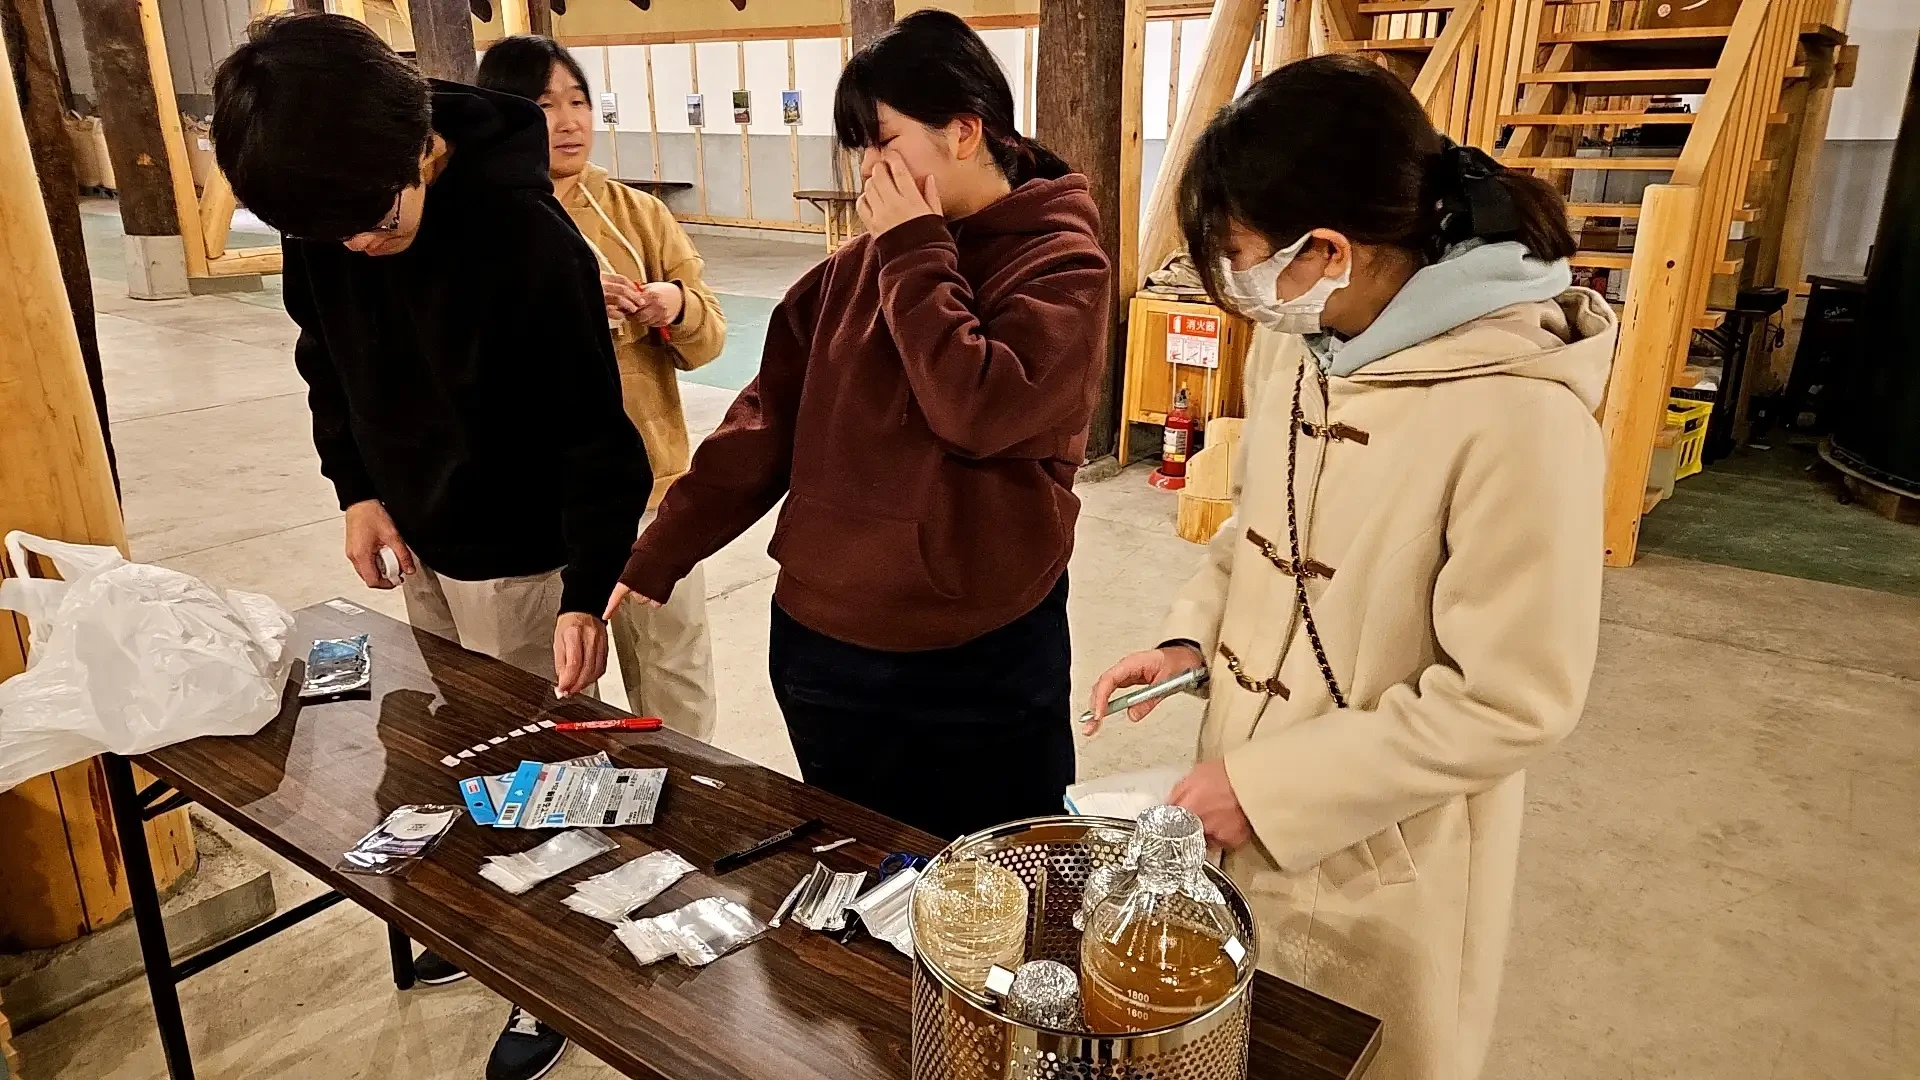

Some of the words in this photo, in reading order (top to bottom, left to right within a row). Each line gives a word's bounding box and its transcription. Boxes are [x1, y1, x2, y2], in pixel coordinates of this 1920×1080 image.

[1186, 319, 1216, 333] 消火器
[1127, 989, 1150, 1003] 1800
[1126, 1007, 1149, 1021] 1600
